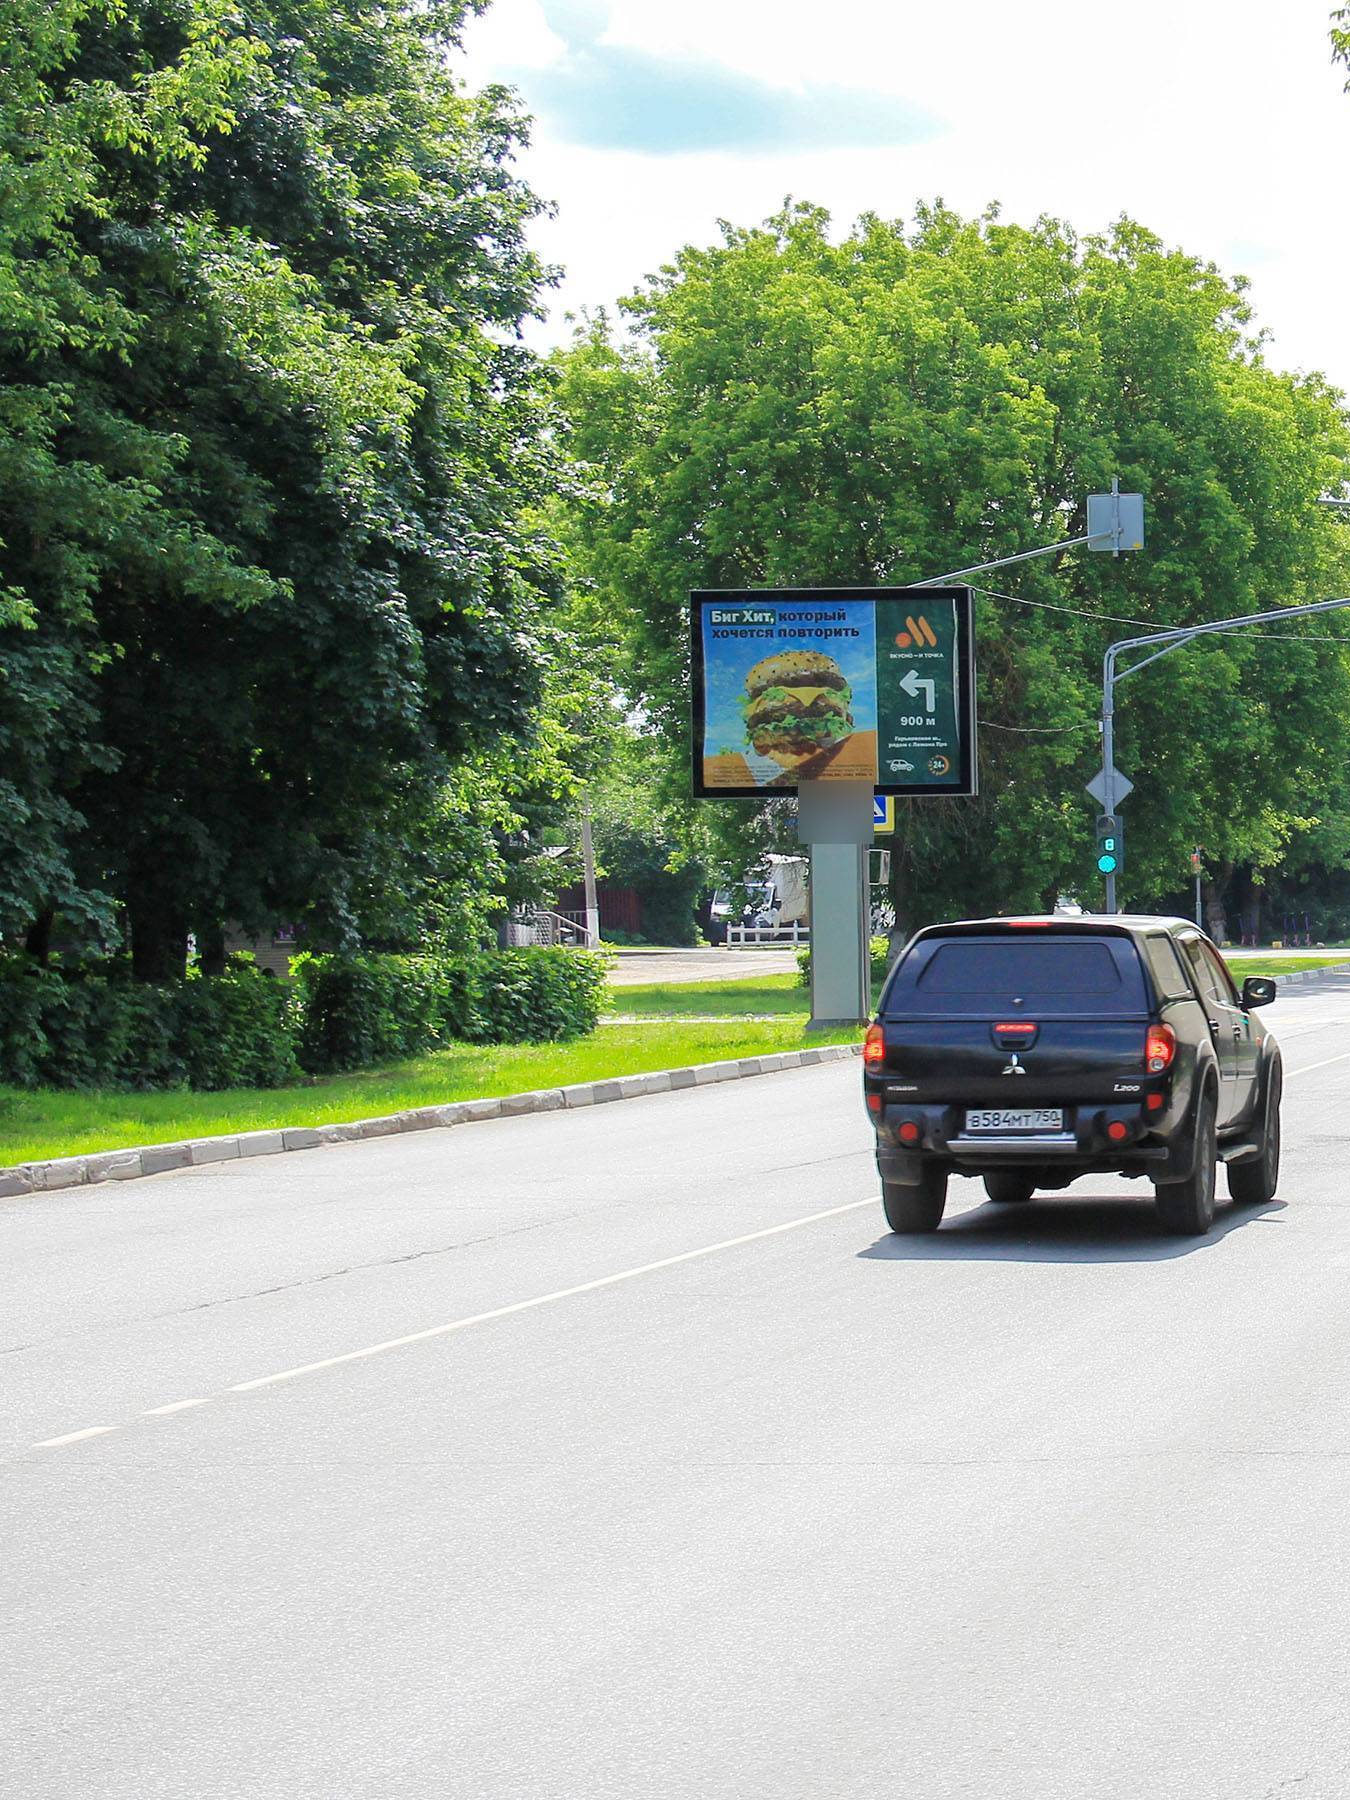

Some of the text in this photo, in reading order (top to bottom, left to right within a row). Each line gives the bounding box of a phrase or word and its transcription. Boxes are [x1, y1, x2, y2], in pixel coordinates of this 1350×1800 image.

[711, 608, 847, 624] Биг Хит, который
[712, 627, 860, 640] хочется повторить
[900, 716, 923, 726] 900
[1113, 1084, 1140, 1092] L200
[1034, 1110, 1059, 1122] 750
